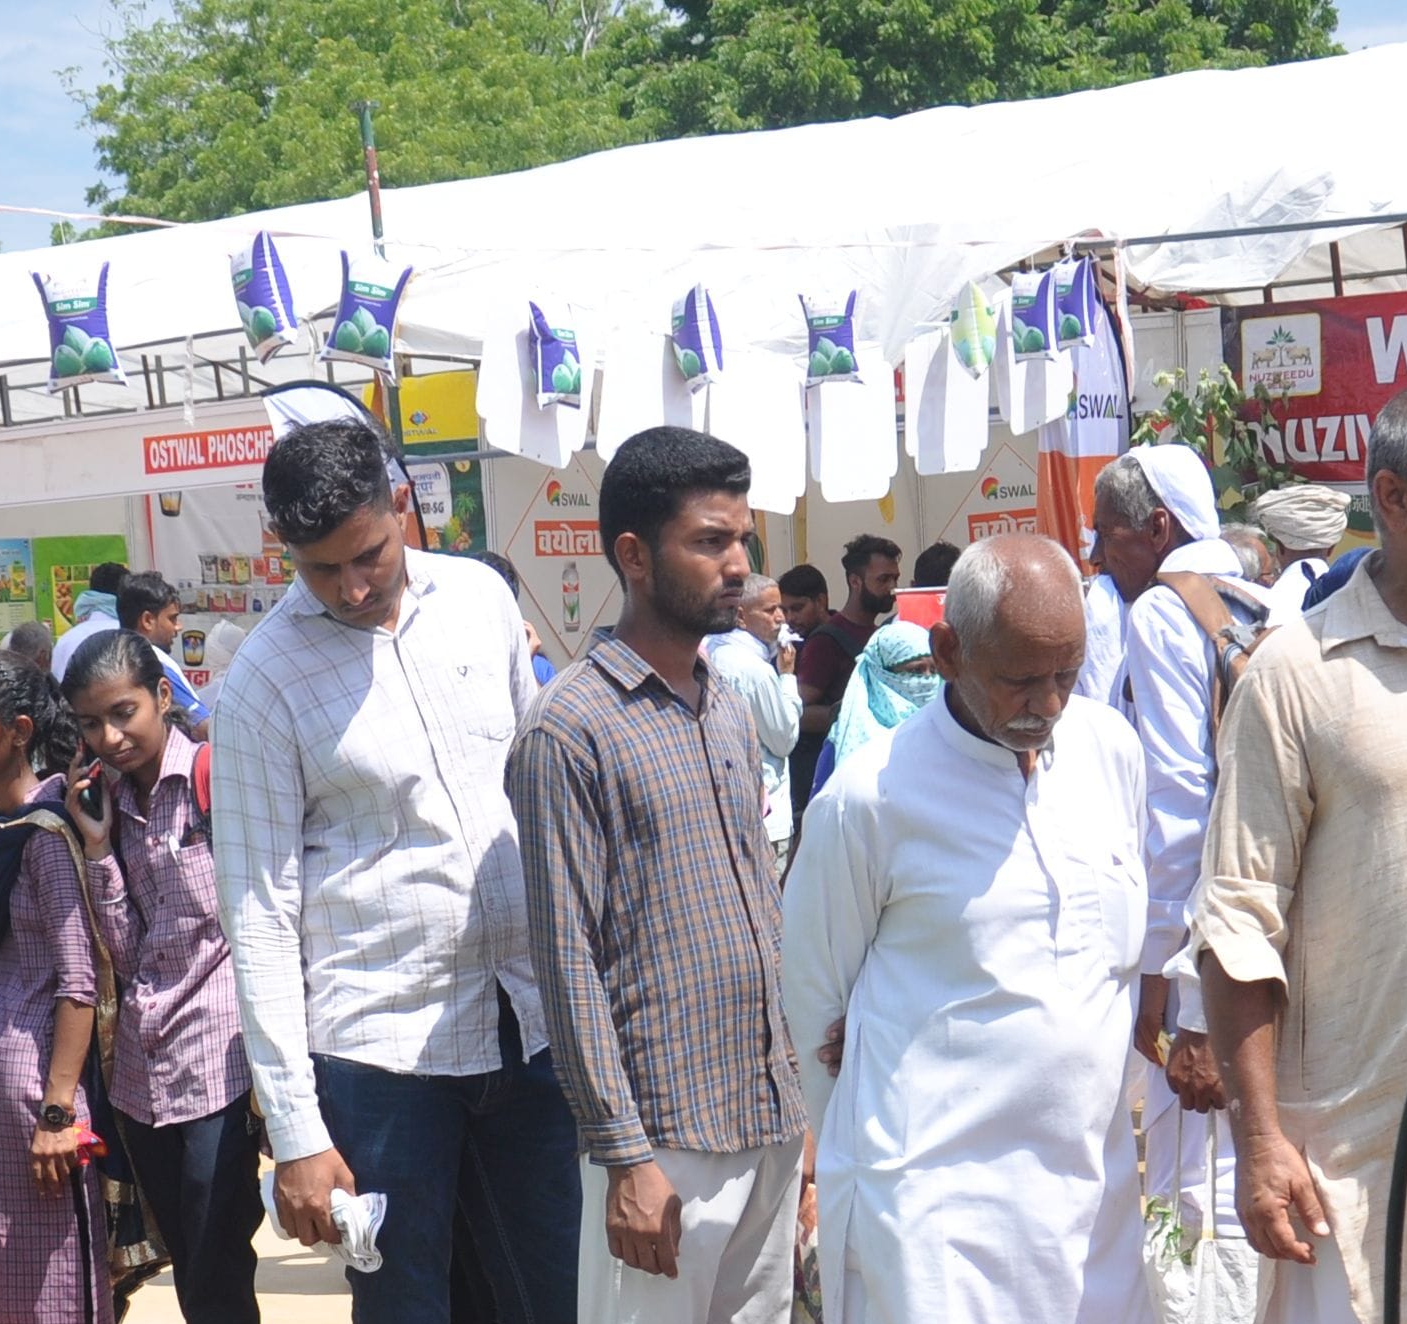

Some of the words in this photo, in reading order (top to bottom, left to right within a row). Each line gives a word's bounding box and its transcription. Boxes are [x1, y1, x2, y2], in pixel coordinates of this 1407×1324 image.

[1249, 369, 1314, 382] NUZEEDU
[149, 436, 205, 469] OSTWAL
[208, 429, 274, 463] PHOSCHE
